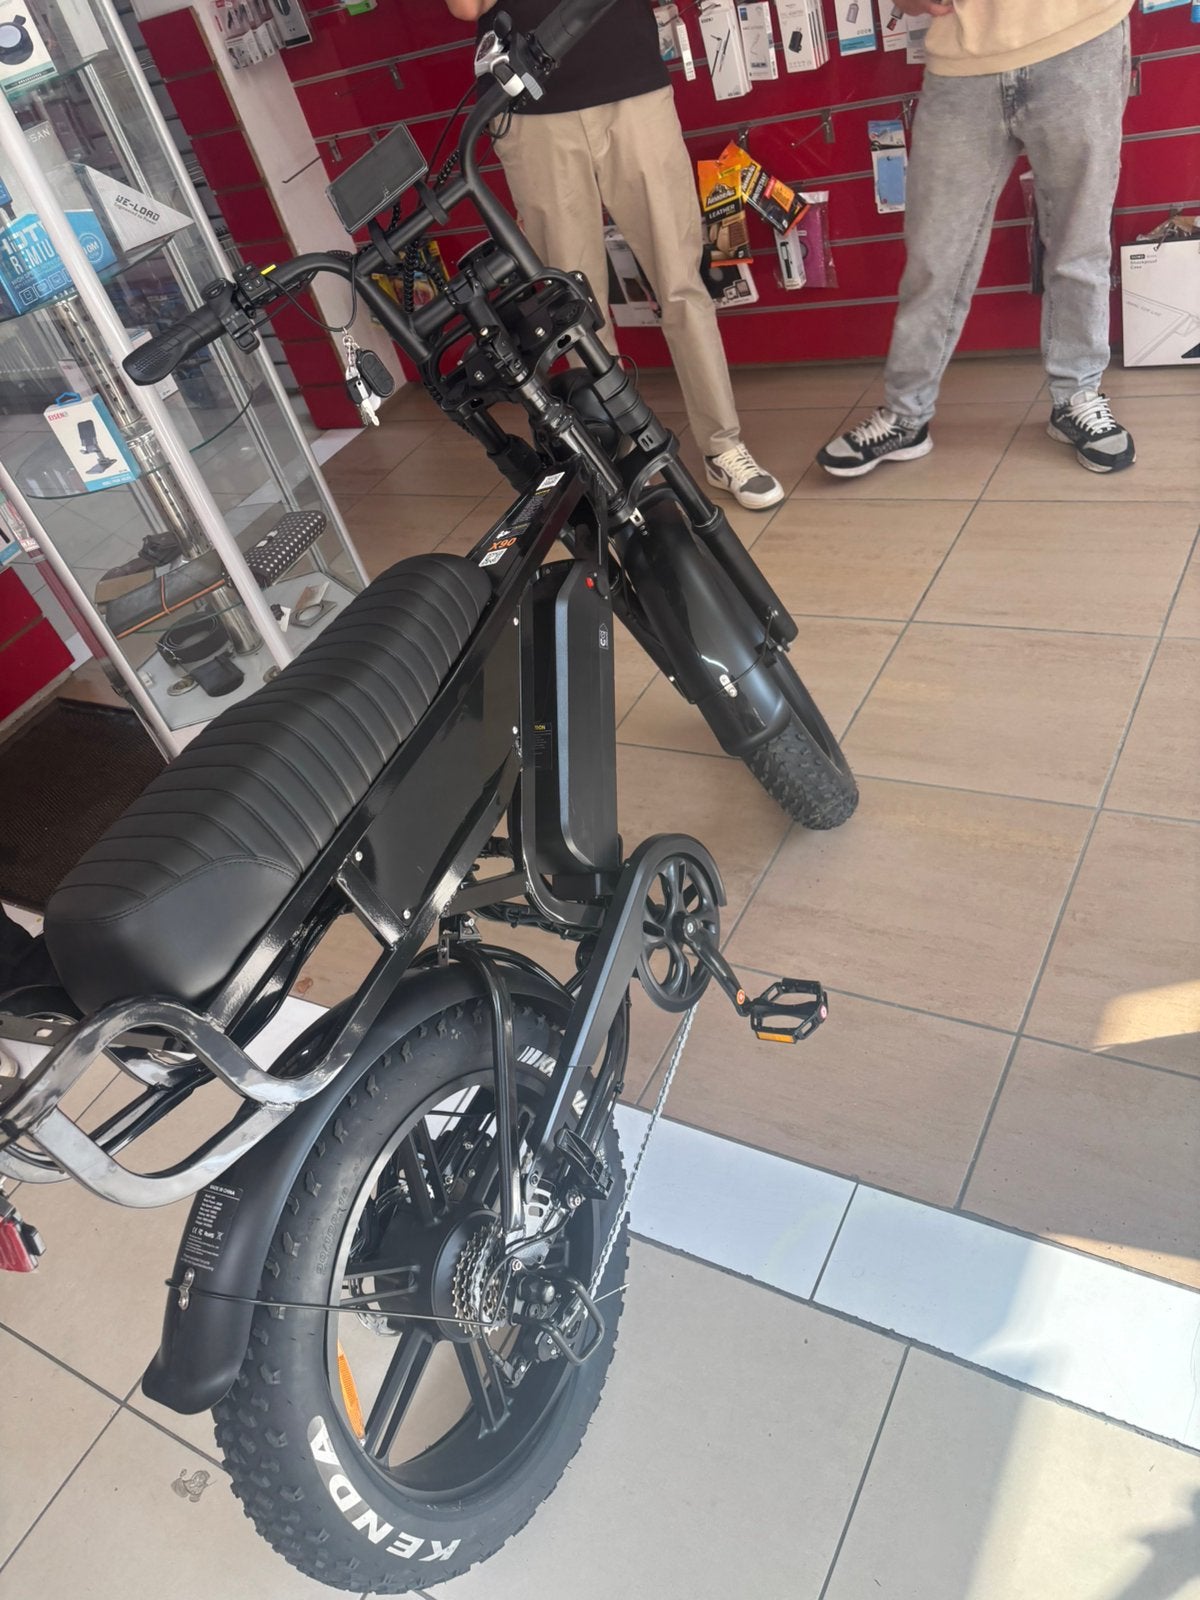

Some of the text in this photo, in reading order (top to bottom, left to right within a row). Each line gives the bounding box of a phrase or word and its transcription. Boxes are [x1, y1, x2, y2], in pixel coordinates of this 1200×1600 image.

[708, 203, 735, 219] LEATHER
[489, 537, 518, 551] X90
[310, 1423, 462, 1562] KENDA
